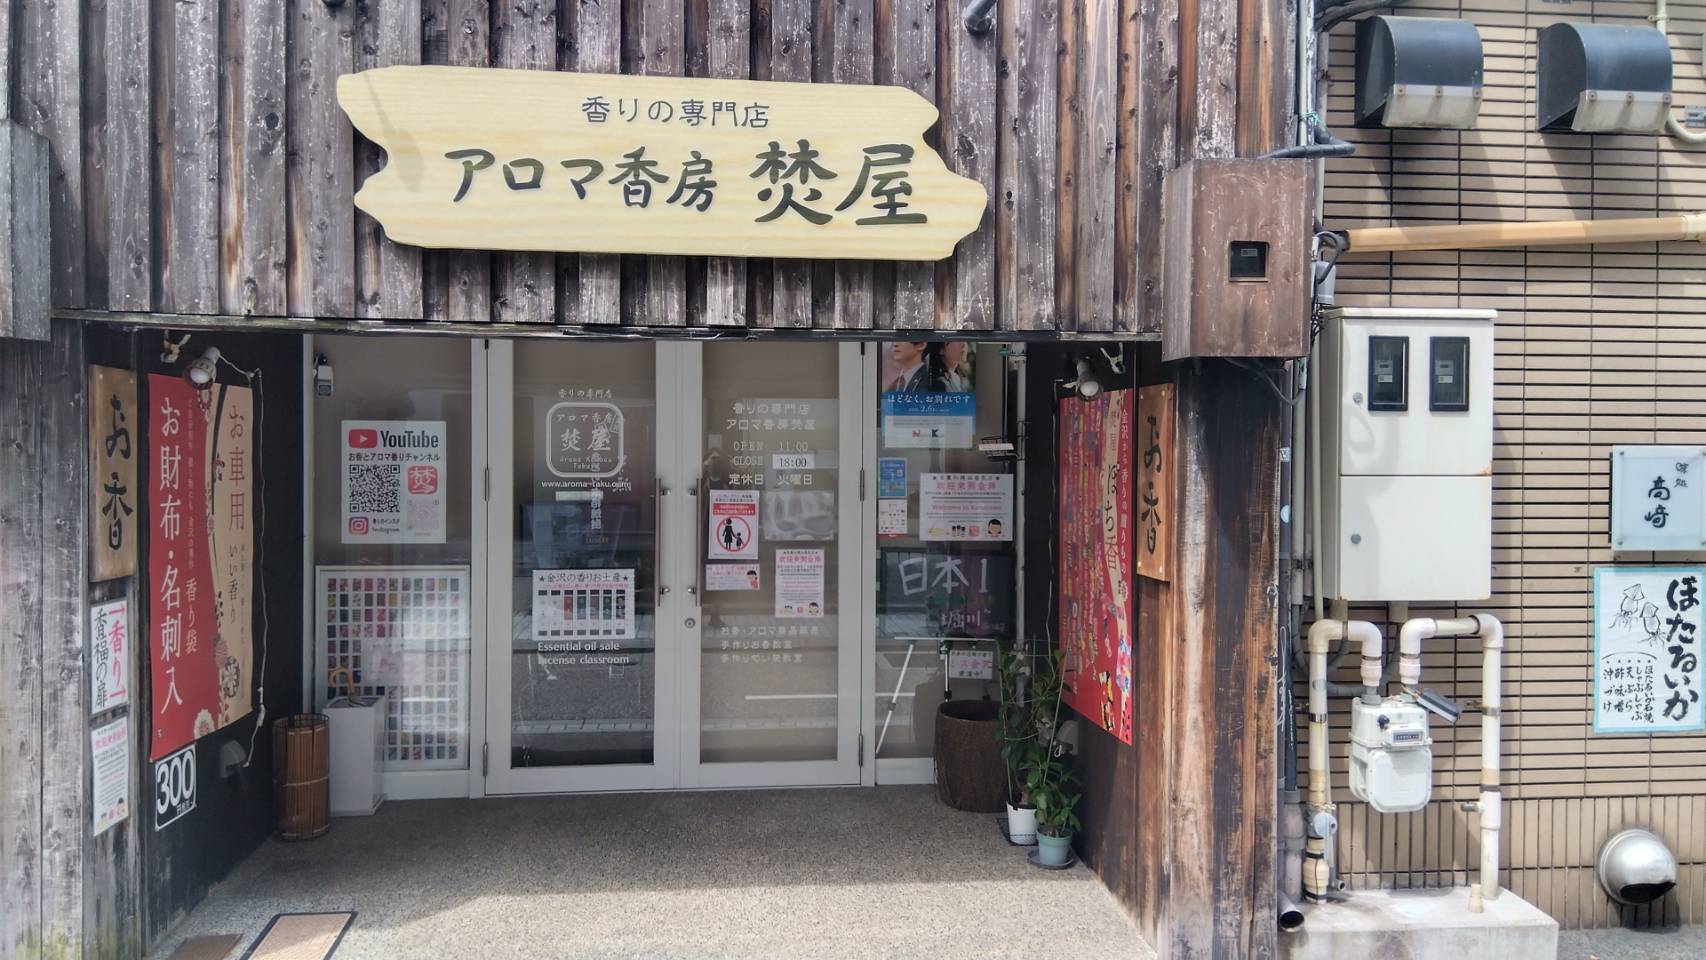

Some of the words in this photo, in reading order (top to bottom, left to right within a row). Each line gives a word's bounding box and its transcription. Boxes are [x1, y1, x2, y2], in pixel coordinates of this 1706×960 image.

[581, 95, 771, 129] 香りの専門店
[444, 146, 717, 213] アロマ香房
[749, 138, 928, 226] 焚屋
[558, 388, 613, 399] 香りの専門店
[380, 430, 439, 448] YouTube
[102, 393, 134, 551] お香
[779, 457, 807, 468] 18:00
[1674, 462, 1689, 488] 味処
[728, 473, 764, 486] 定休日
[777, 473, 813, 486] 火曜日
[1141, 415, 1163, 556] お香
[108, 619, 126, 688] 香り
[537, 641, 581, 652] Essential
[584, 641, 597, 651] oil
[599, 641, 620, 651] sale
[579, 654, 630, 665] classroom
[1662, 575, 1700, 722] ほたるいか
[156, 750, 194, 815] 300
